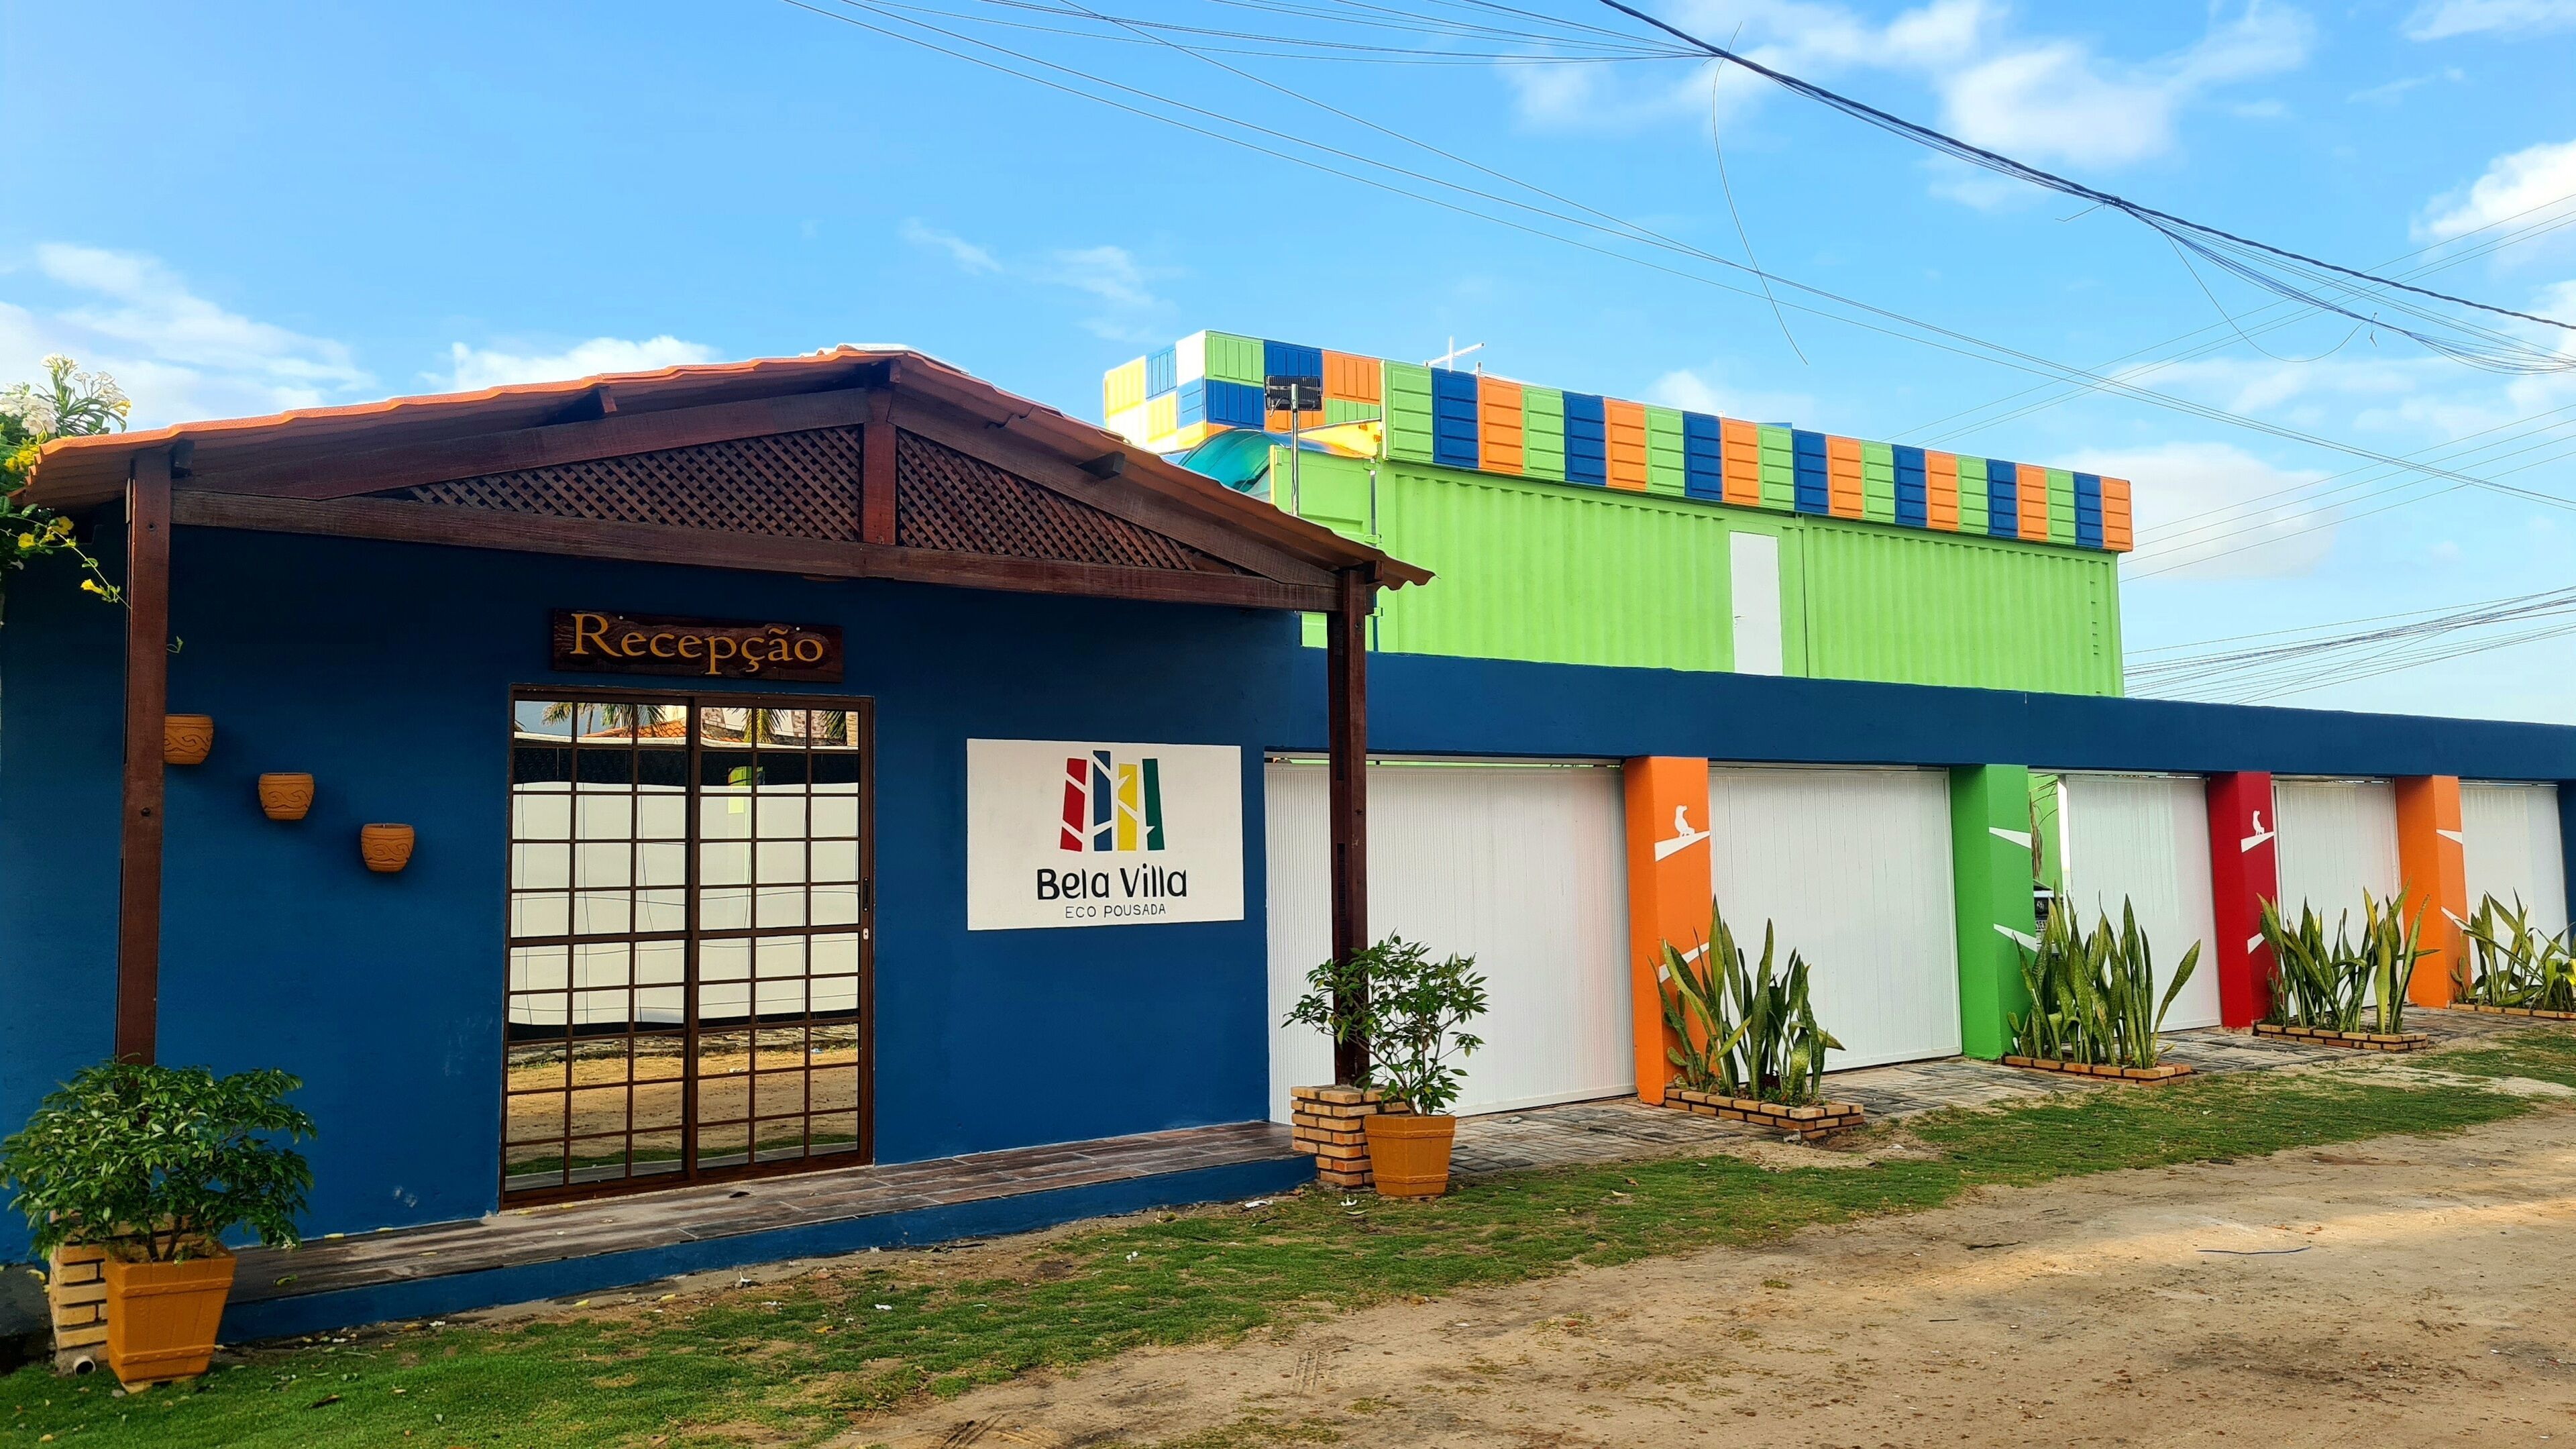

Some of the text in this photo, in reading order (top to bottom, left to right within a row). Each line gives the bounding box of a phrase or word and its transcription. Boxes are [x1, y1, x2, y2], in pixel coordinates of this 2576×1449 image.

[570, 612, 824, 676] Recepção
[1037, 863, 1187, 900] Bela Villa
[1065, 904, 1166, 919] ECO POUSADA
